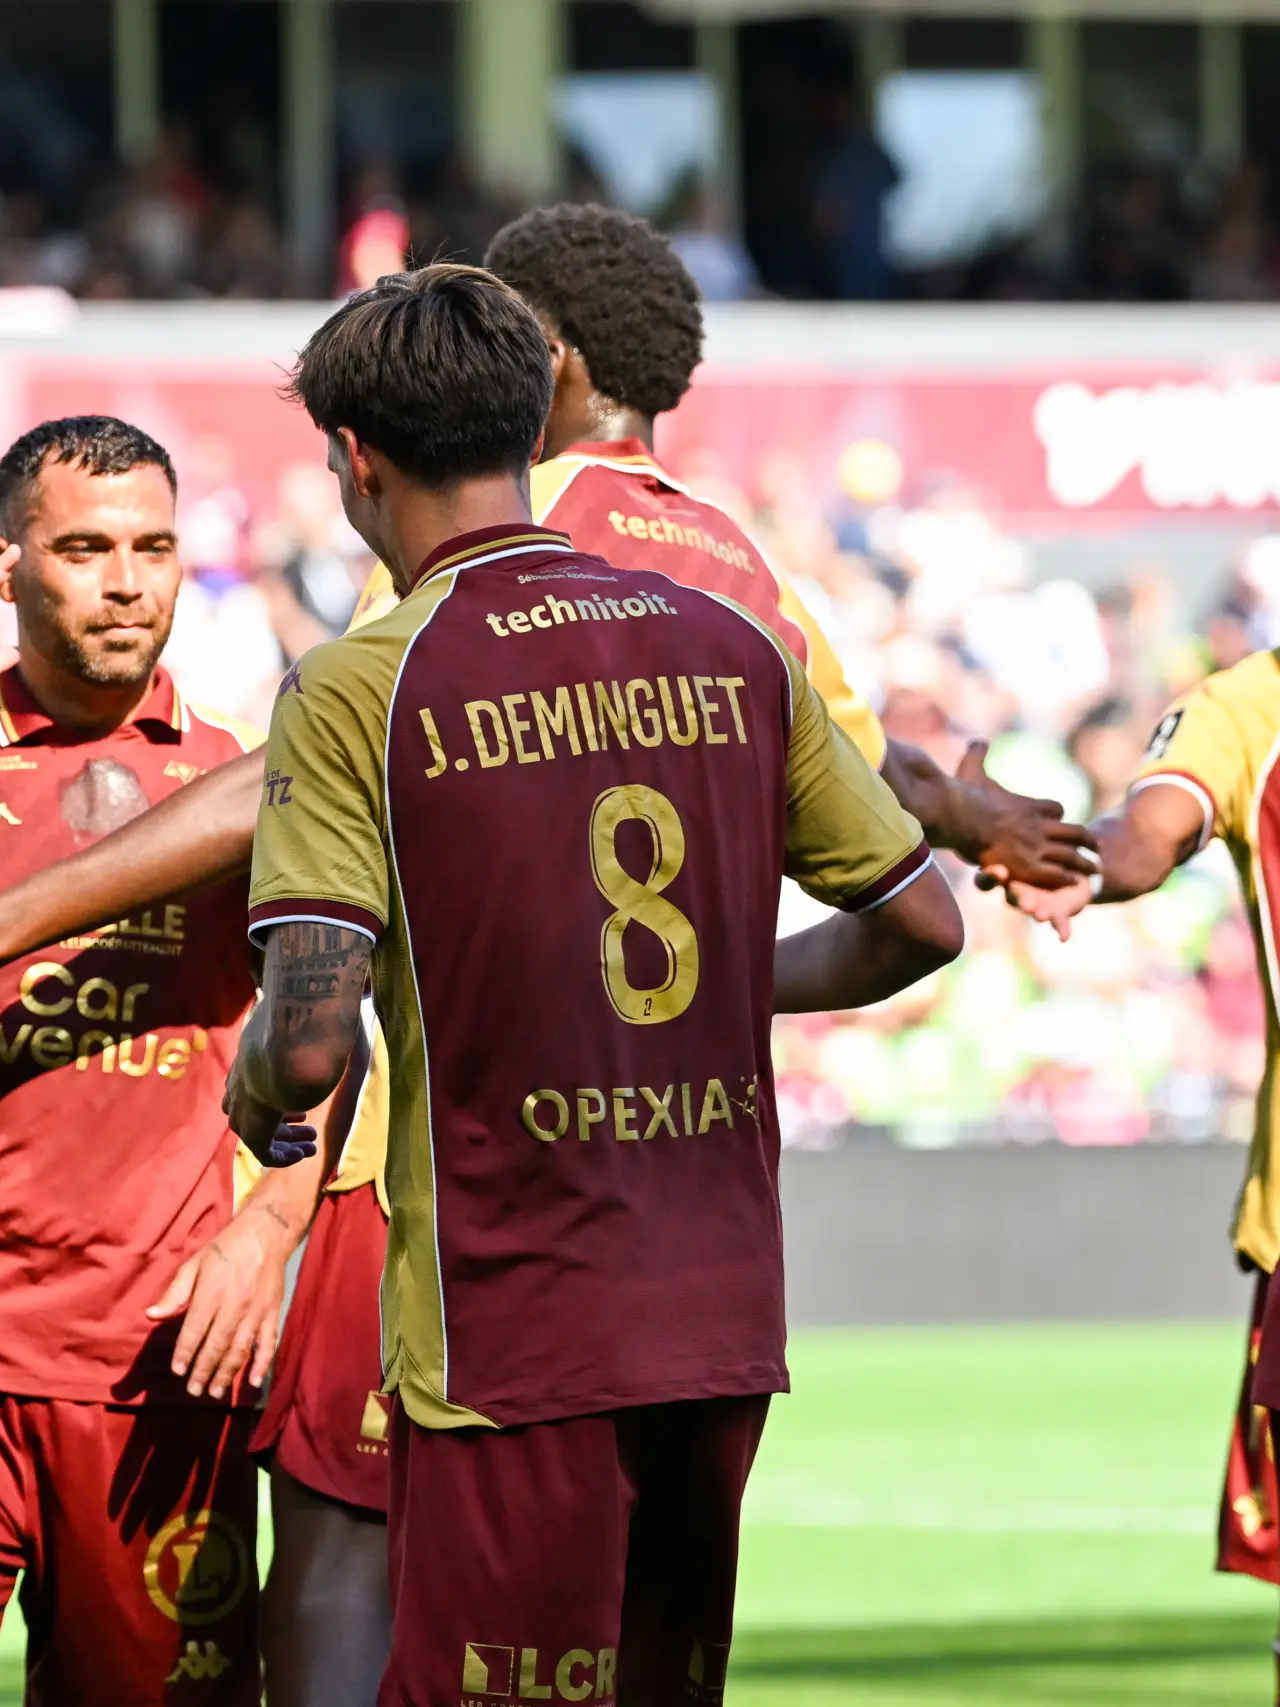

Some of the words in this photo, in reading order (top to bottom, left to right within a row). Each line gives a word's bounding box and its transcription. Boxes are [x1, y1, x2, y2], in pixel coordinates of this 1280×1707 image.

[486, 590, 678, 638] technitoit.
[418, 676, 749, 779] J.DEMINGUET
[266, 776, 294, 806] TZ
[588, 783, 700, 1025] 8
[19, 961, 149, 1022] Car
[521, 1078, 736, 1143] OPEXIA
[518, 1647, 617, 1702] LCR
